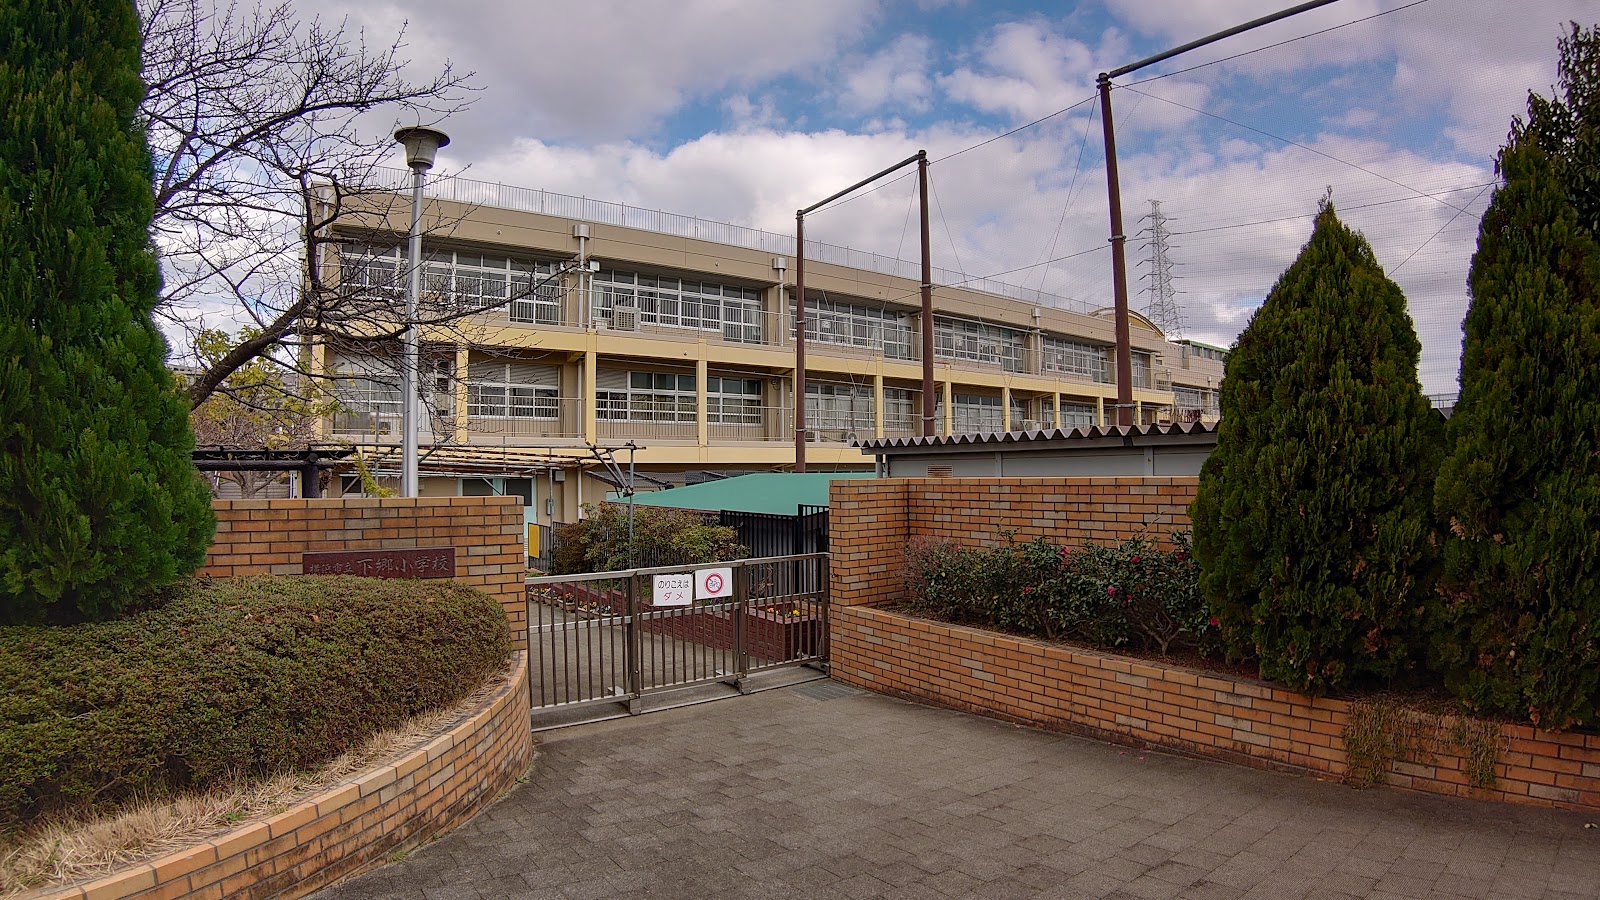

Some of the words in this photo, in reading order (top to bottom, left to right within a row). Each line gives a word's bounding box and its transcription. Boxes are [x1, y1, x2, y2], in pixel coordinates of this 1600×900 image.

[657, 580, 689, 589] のりこえは
[663, 591, 684, 601] ダメ
